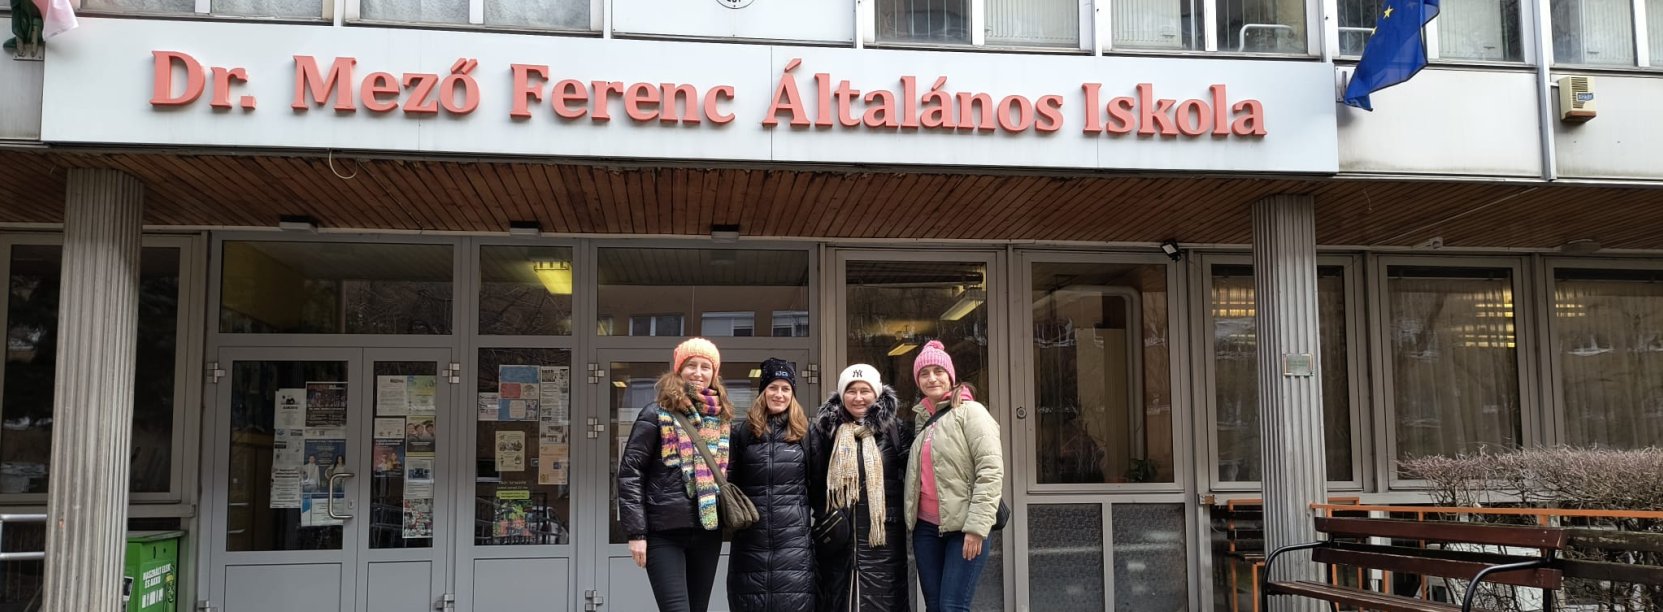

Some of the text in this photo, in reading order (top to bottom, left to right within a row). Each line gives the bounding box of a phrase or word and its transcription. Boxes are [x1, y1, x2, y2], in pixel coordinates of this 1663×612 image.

[150, 51, 1267, 138] Dr. Mező Ferenc Általános Iskola
